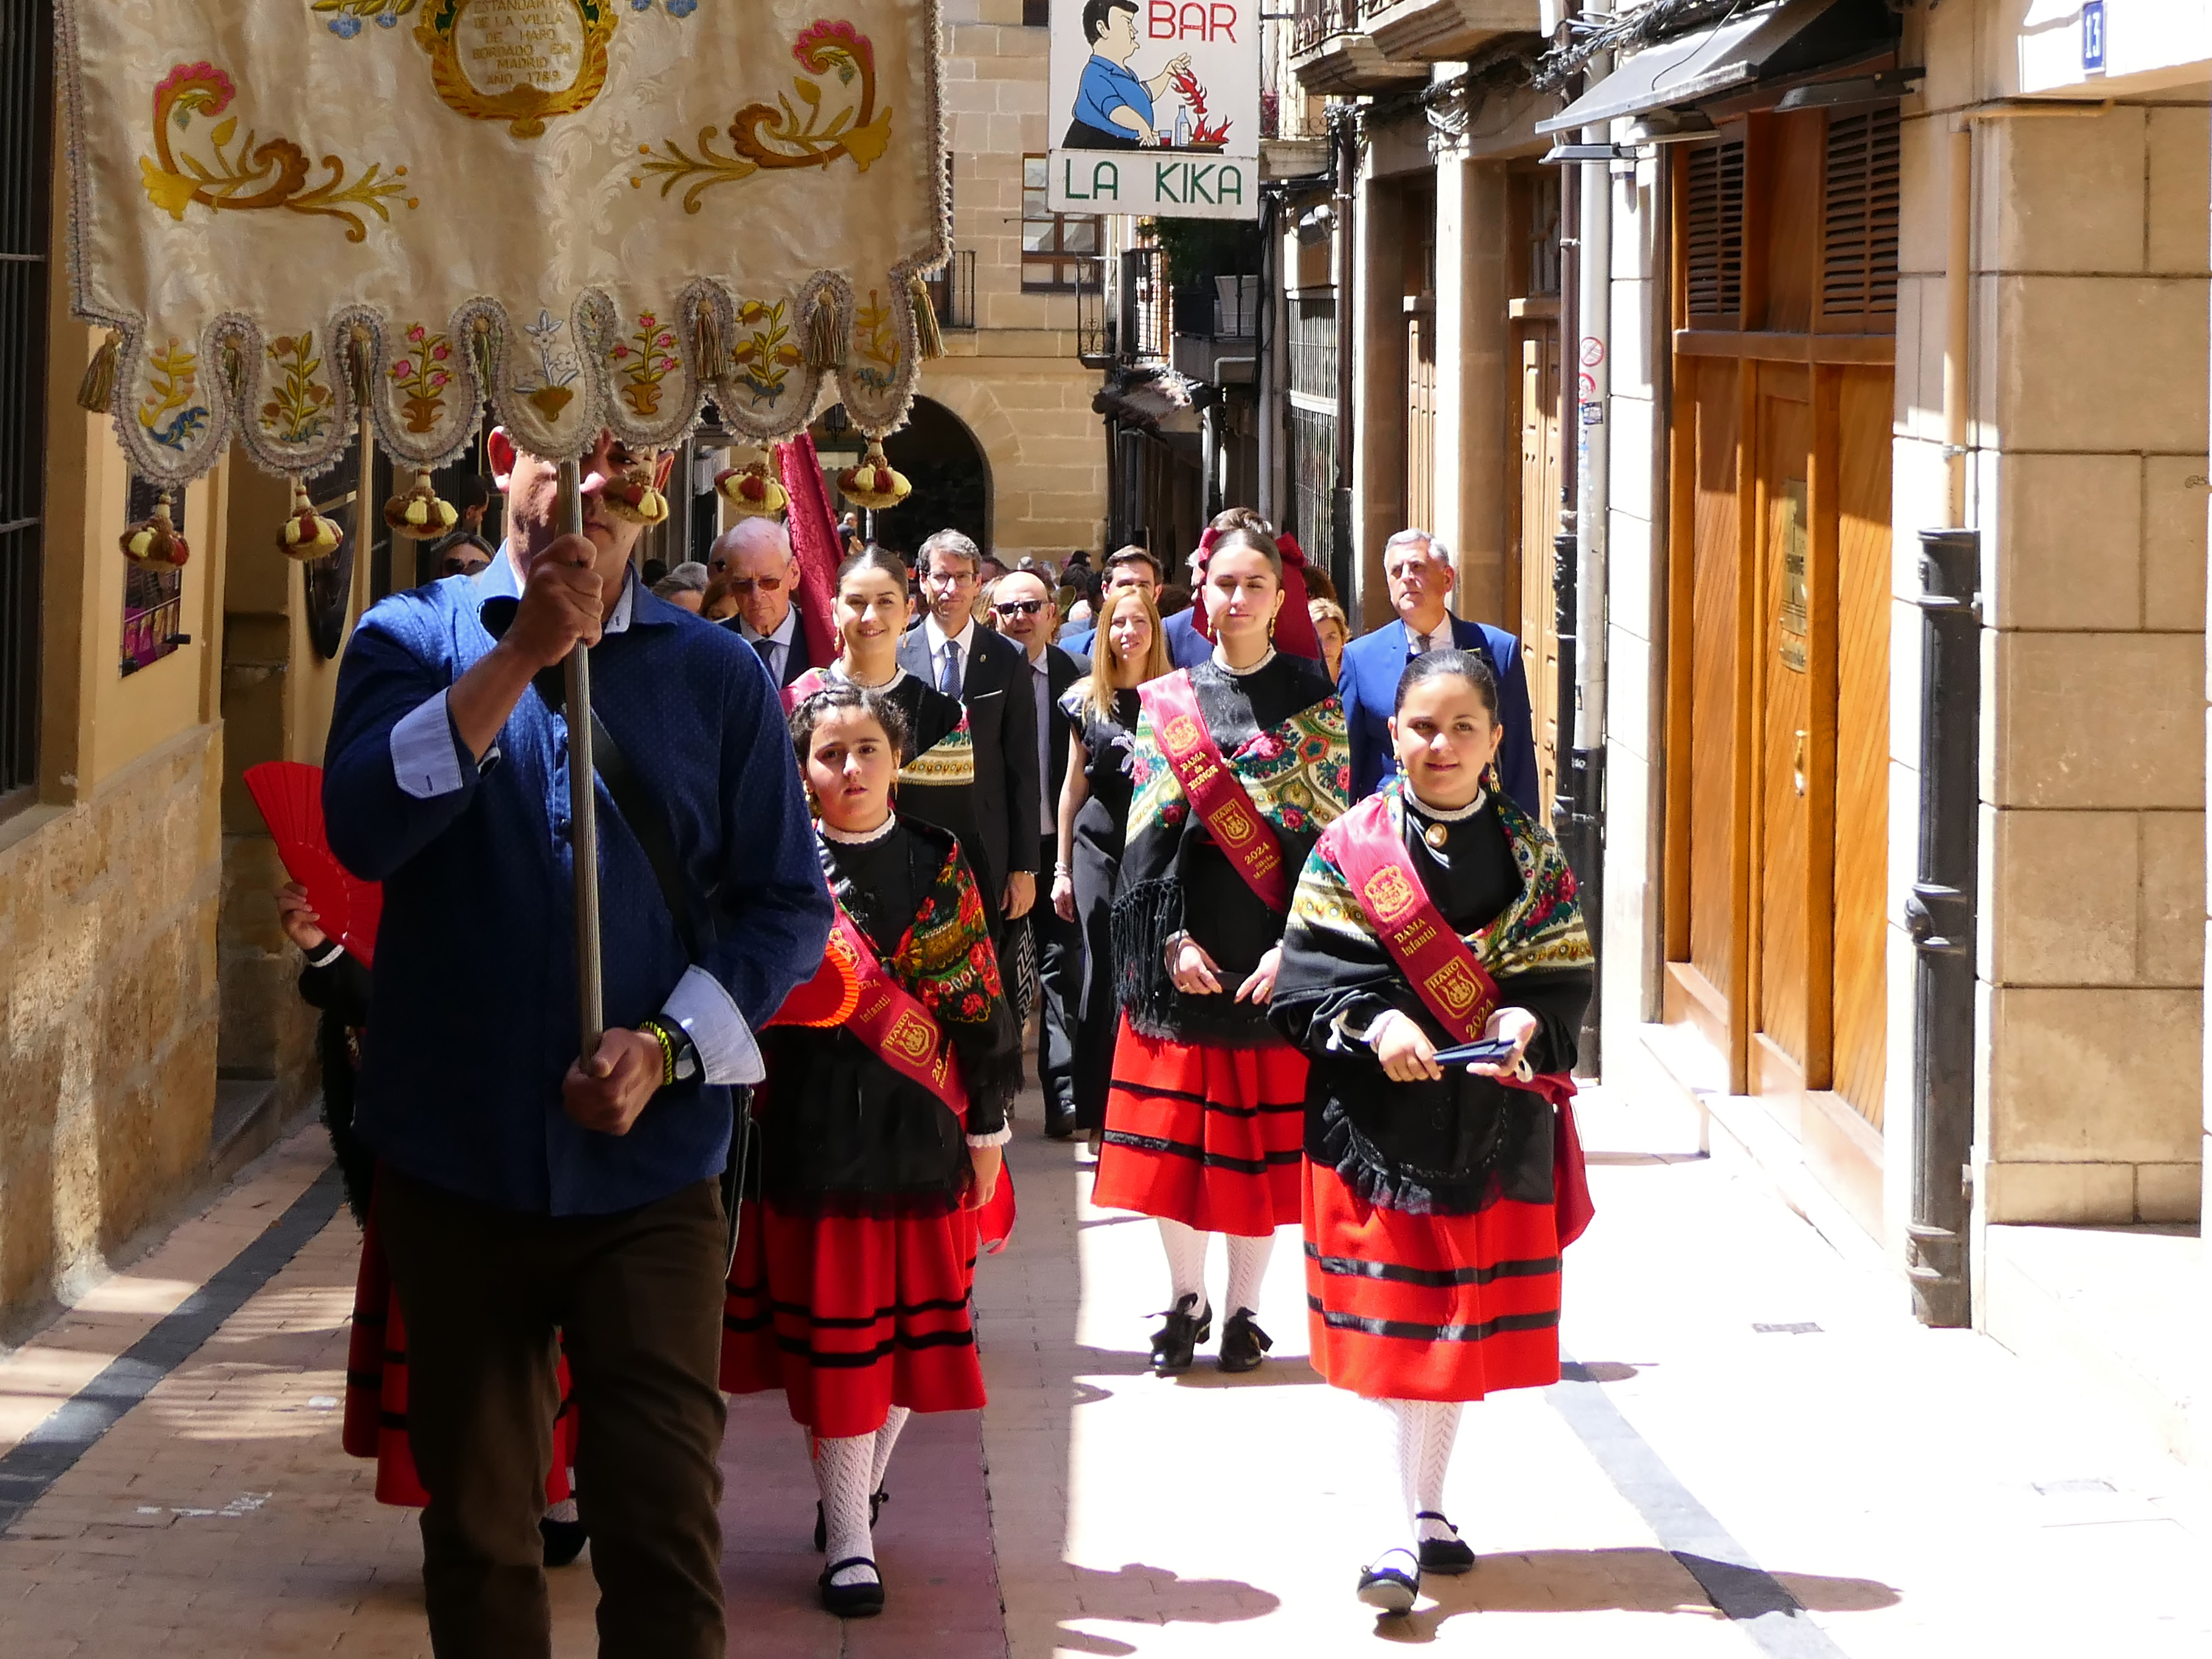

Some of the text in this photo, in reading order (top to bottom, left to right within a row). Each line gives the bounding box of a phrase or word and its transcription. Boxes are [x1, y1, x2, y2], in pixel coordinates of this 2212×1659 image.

[520, 29, 557, 41] HARO
[1148, 0, 1237, 44] BAR
[2086, 12, 2101, 58] 13
[1065, 159, 1242, 205] LA KIKA
[1187, 765, 1219, 790] HONOR
[1394, 918, 1426, 944] DAMA
[1401, 926, 1437, 956] Infantil
[1430, 961, 1460, 989] HARO
[885, 1012, 909, 1046] HARO
